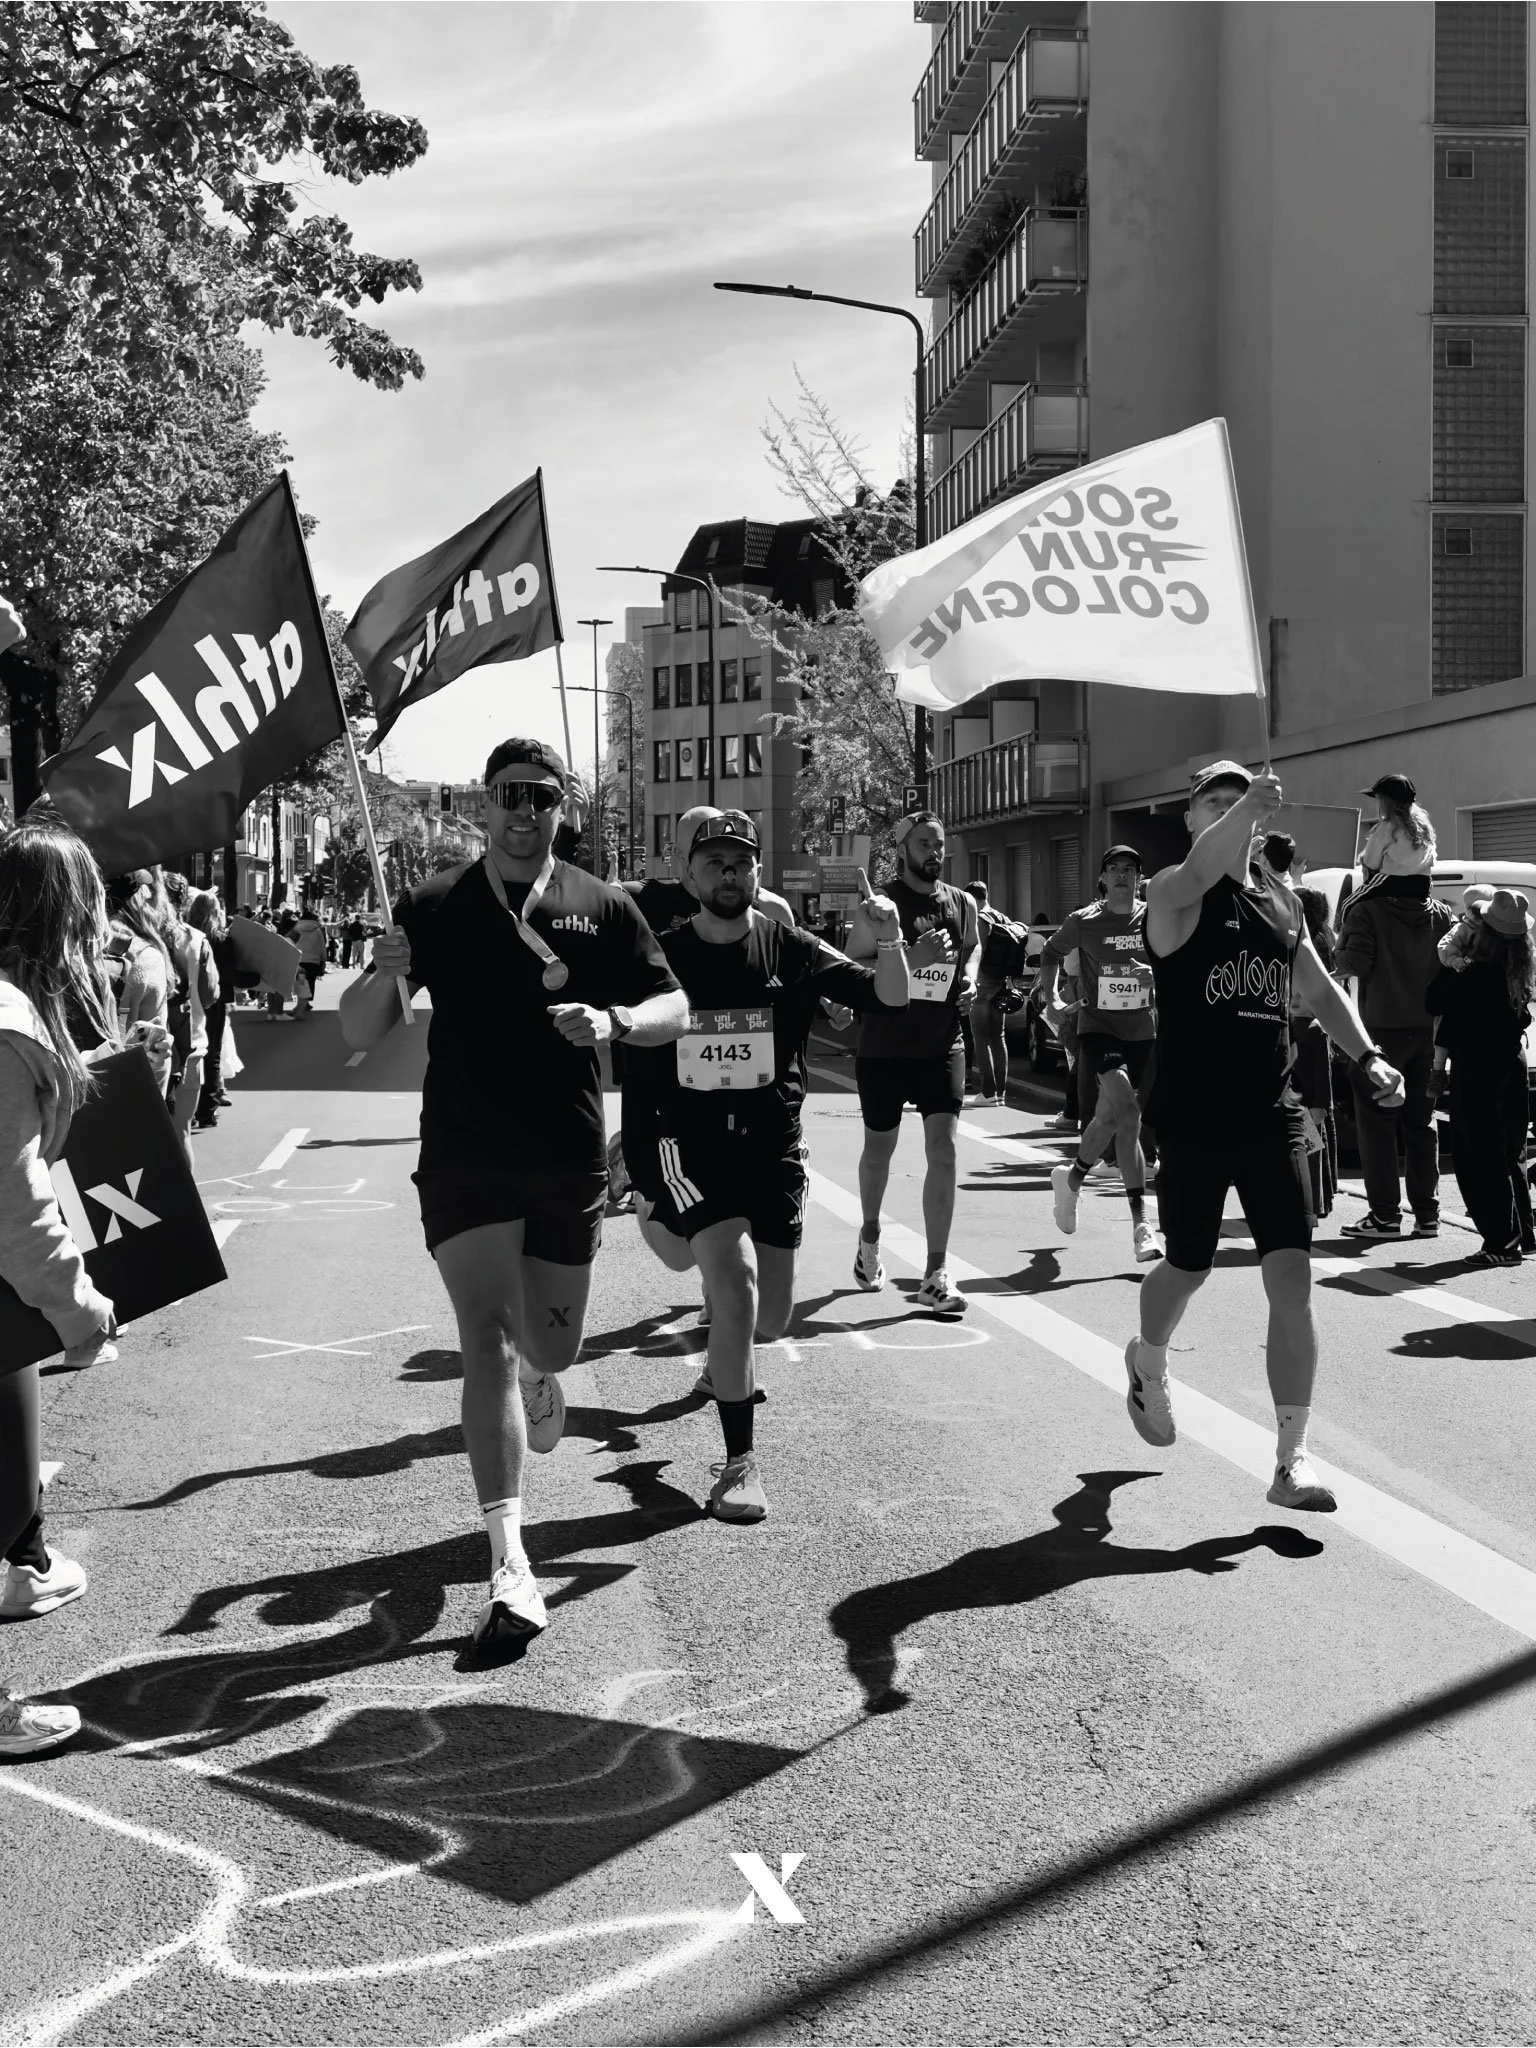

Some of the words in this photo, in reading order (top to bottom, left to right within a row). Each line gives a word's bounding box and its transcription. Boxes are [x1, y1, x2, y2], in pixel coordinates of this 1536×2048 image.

[906, 789, 918, 808] P
[551, 914, 599, 936] athlx
[1103, 934, 1142, 944] AUSDAUE
[1115, 941, 1144, 951] SCHUL
[913, 968, 948, 982] 4406
[1109, 983, 1142, 994] S9411
[689, 1013, 698, 1022] ni
[714, 1012, 730, 1023] uni
[745, 1010, 761, 1021] uni
[717, 1020, 736, 1032] per
[749, 1019, 768, 1030] per
[699, 1043, 752, 1062] 4143
